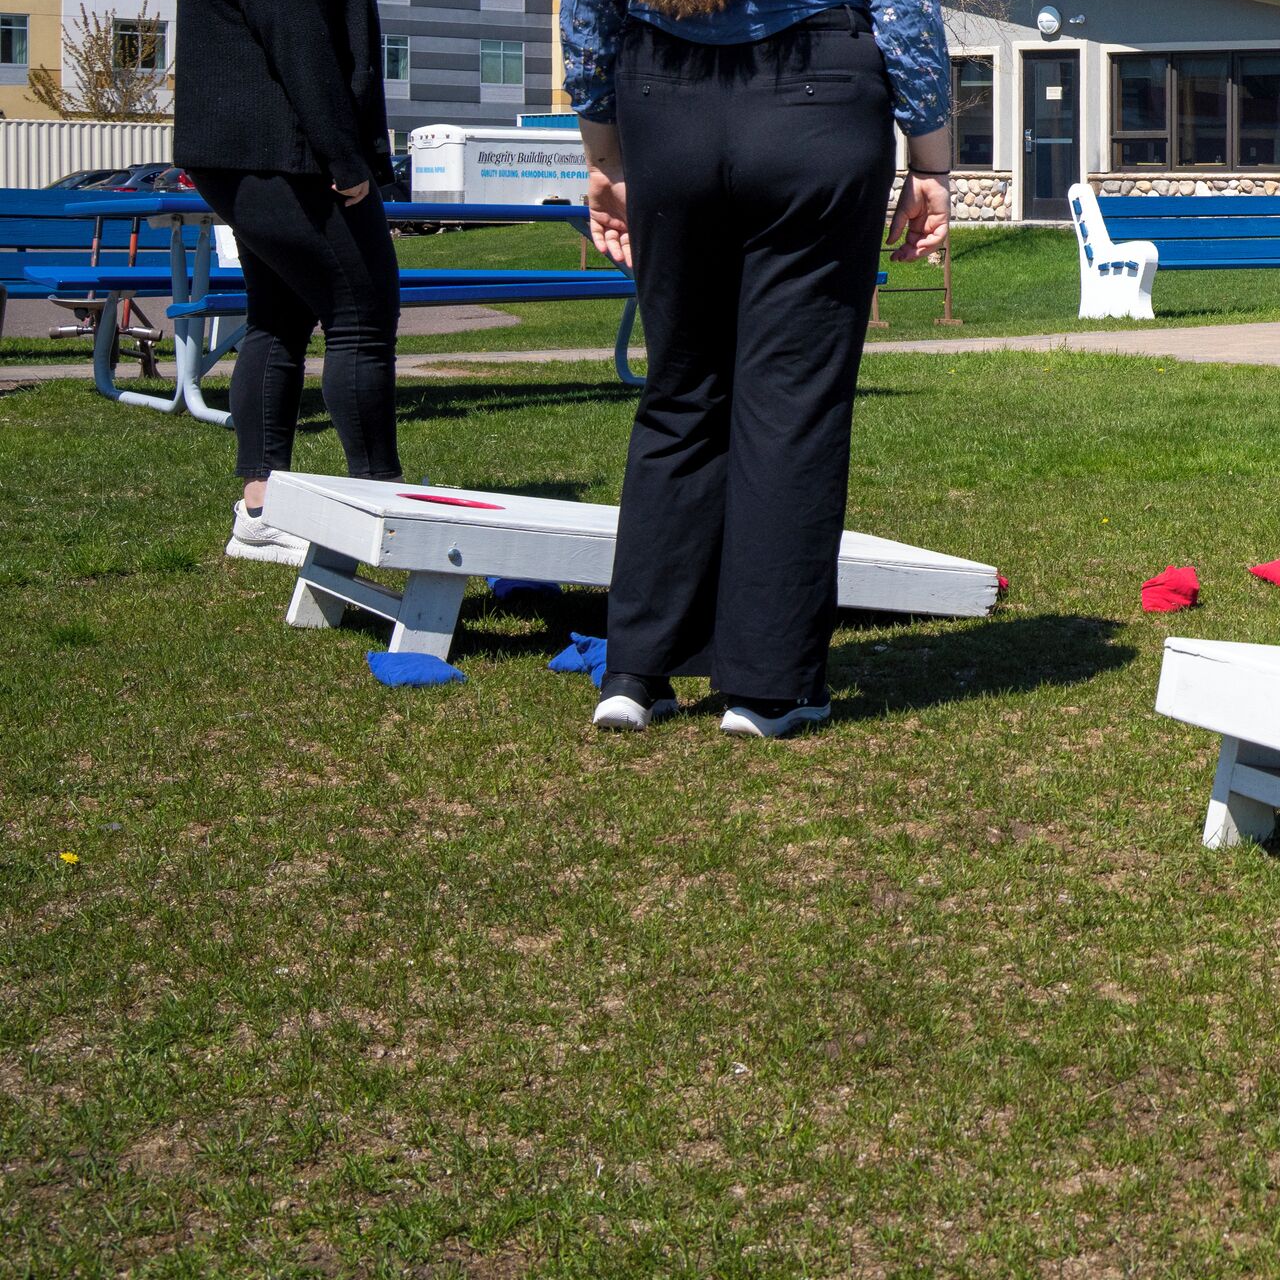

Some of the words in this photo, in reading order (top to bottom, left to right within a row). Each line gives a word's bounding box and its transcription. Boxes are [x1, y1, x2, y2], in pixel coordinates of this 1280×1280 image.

[478, 151, 515, 166] Integrity
[517, 151, 553, 166] Building
[553, 152, 587, 163] Constructi
